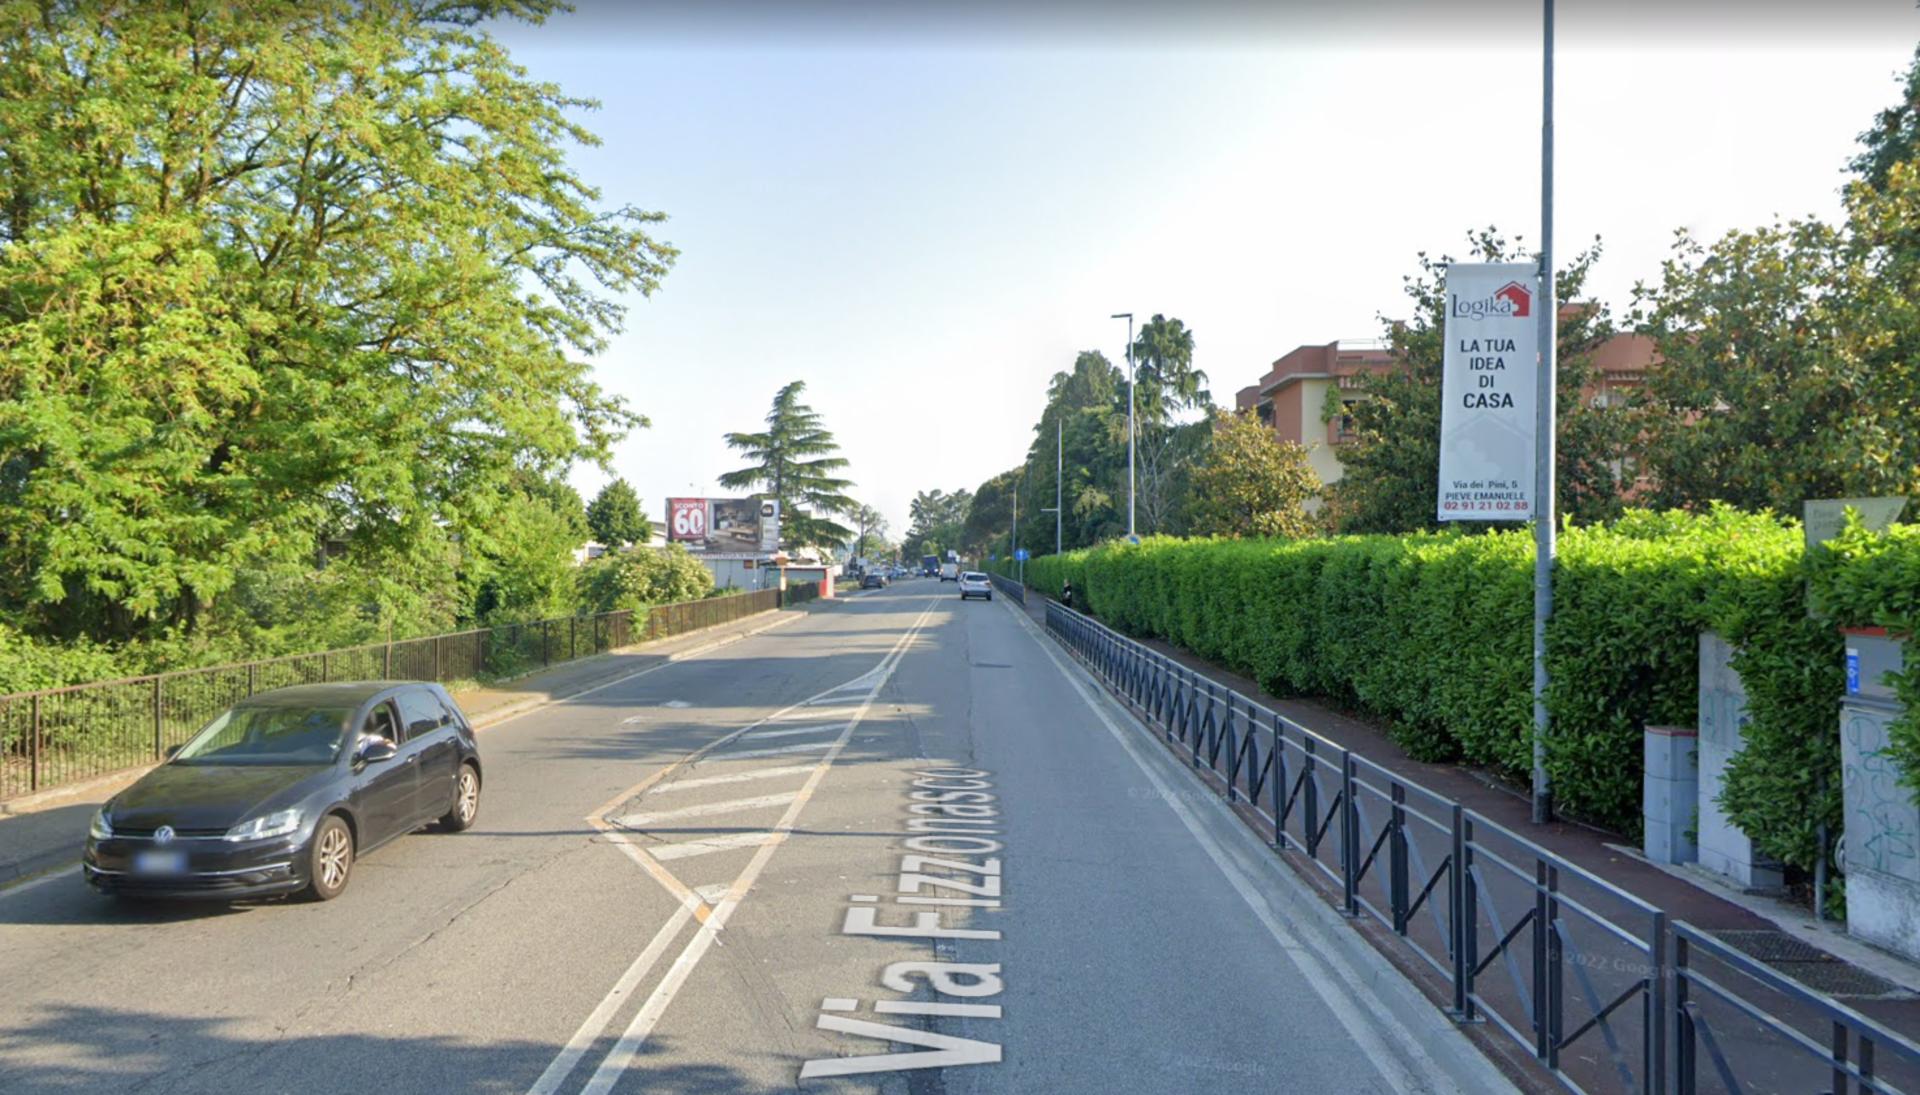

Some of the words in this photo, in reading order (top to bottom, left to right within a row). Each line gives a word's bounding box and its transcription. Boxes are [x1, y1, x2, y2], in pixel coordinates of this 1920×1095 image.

[1460, 340, 1480, 352] LA
[1485, 339, 1516, 352] TUA
[1470, 357, 1505, 370] IDEA
[1479, 376, 1494, 388] DI
[1463, 393, 1514, 408] CASA
[1453, 480, 1468, 489] Via
[1470, 480, 1483, 489] dei
[1488, 480, 1509, 489] Pini,
[1445, 492, 1471, 500] PIEVE
[1474, 492, 1525, 500] EMANUELE
[1444, 501, 1459, 510] 02
[1462, 501, 1474, 510] 91
[1479, 501, 1492, 510] 21
[1496, 501, 1511, 510] 02
[1514, 501, 1528, 510] 88
[674, 509, 704, 535] 60
